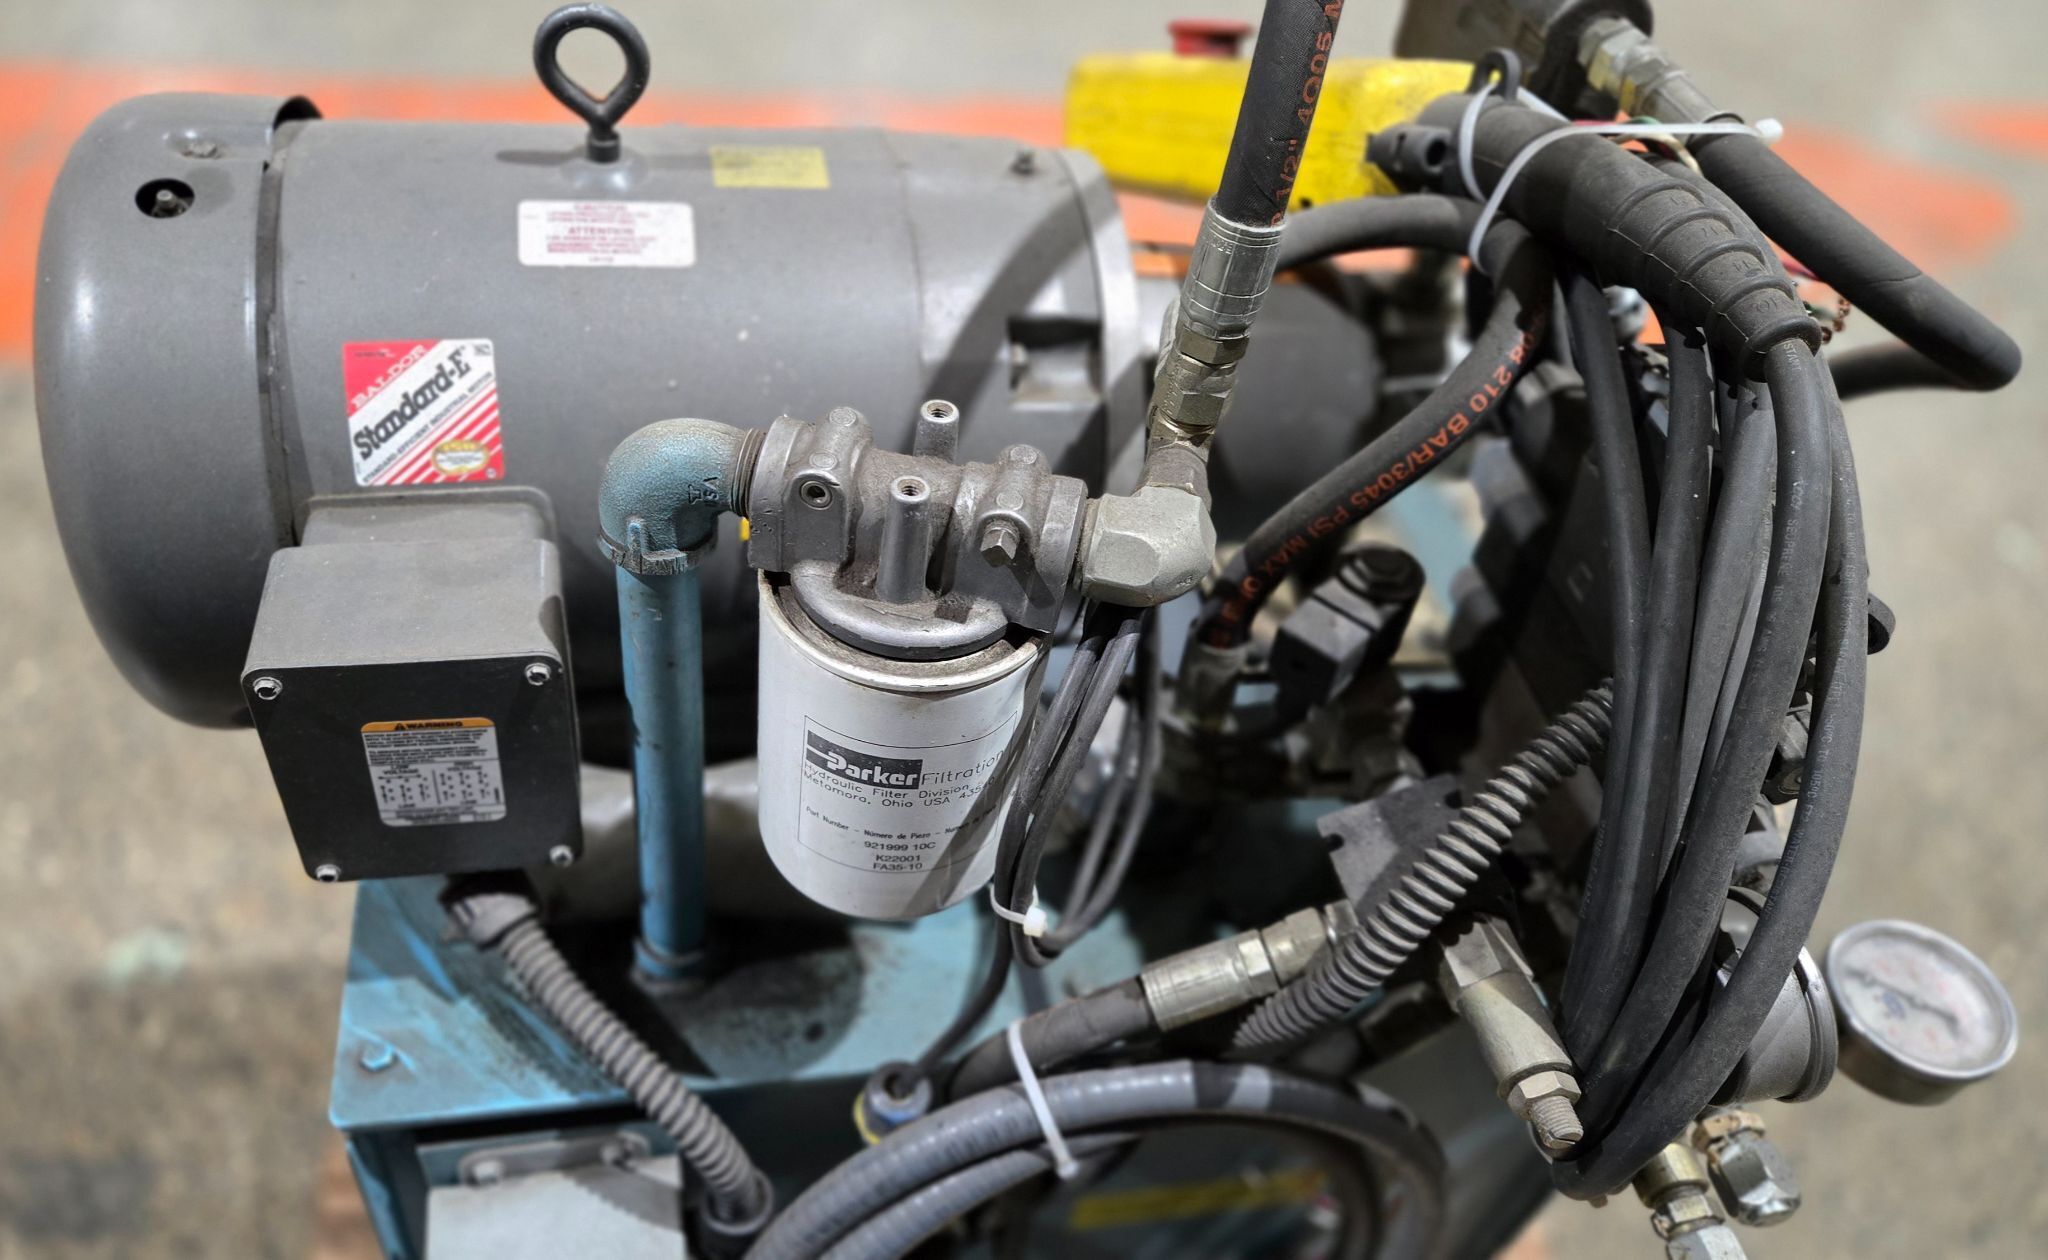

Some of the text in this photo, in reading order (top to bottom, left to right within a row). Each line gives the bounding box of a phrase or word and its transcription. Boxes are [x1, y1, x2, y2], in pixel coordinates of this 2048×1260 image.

[1297, 32, 1333, 125] 4005
[350, 345, 428, 409] BALDOR
[1469, 365, 1514, 414] 210
[353, 347, 471, 460] Standard-E
[1350, 411, 1470, 508] BAR/3045
[1306, 505, 1349, 539] PSI
[1262, 534, 1309, 575] MAX
[407, 722, 464, 731] WARNING
[804, 764, 863, 793] Hydraulic
[872, 788, 908, 799] Filter
[826, 750, 1004, 786] Parker Filtration
[806, 806, 820, 818] Part
[822, 815, 850, 830] Number
[881, 798, 913, 808] Ohio
[923, 796, 951, 807] USA
[864, 841, 937, 851] 921999 10C
[875, 855, 921, 863] K22001
[873, 863, 923, 871] FA35-10
